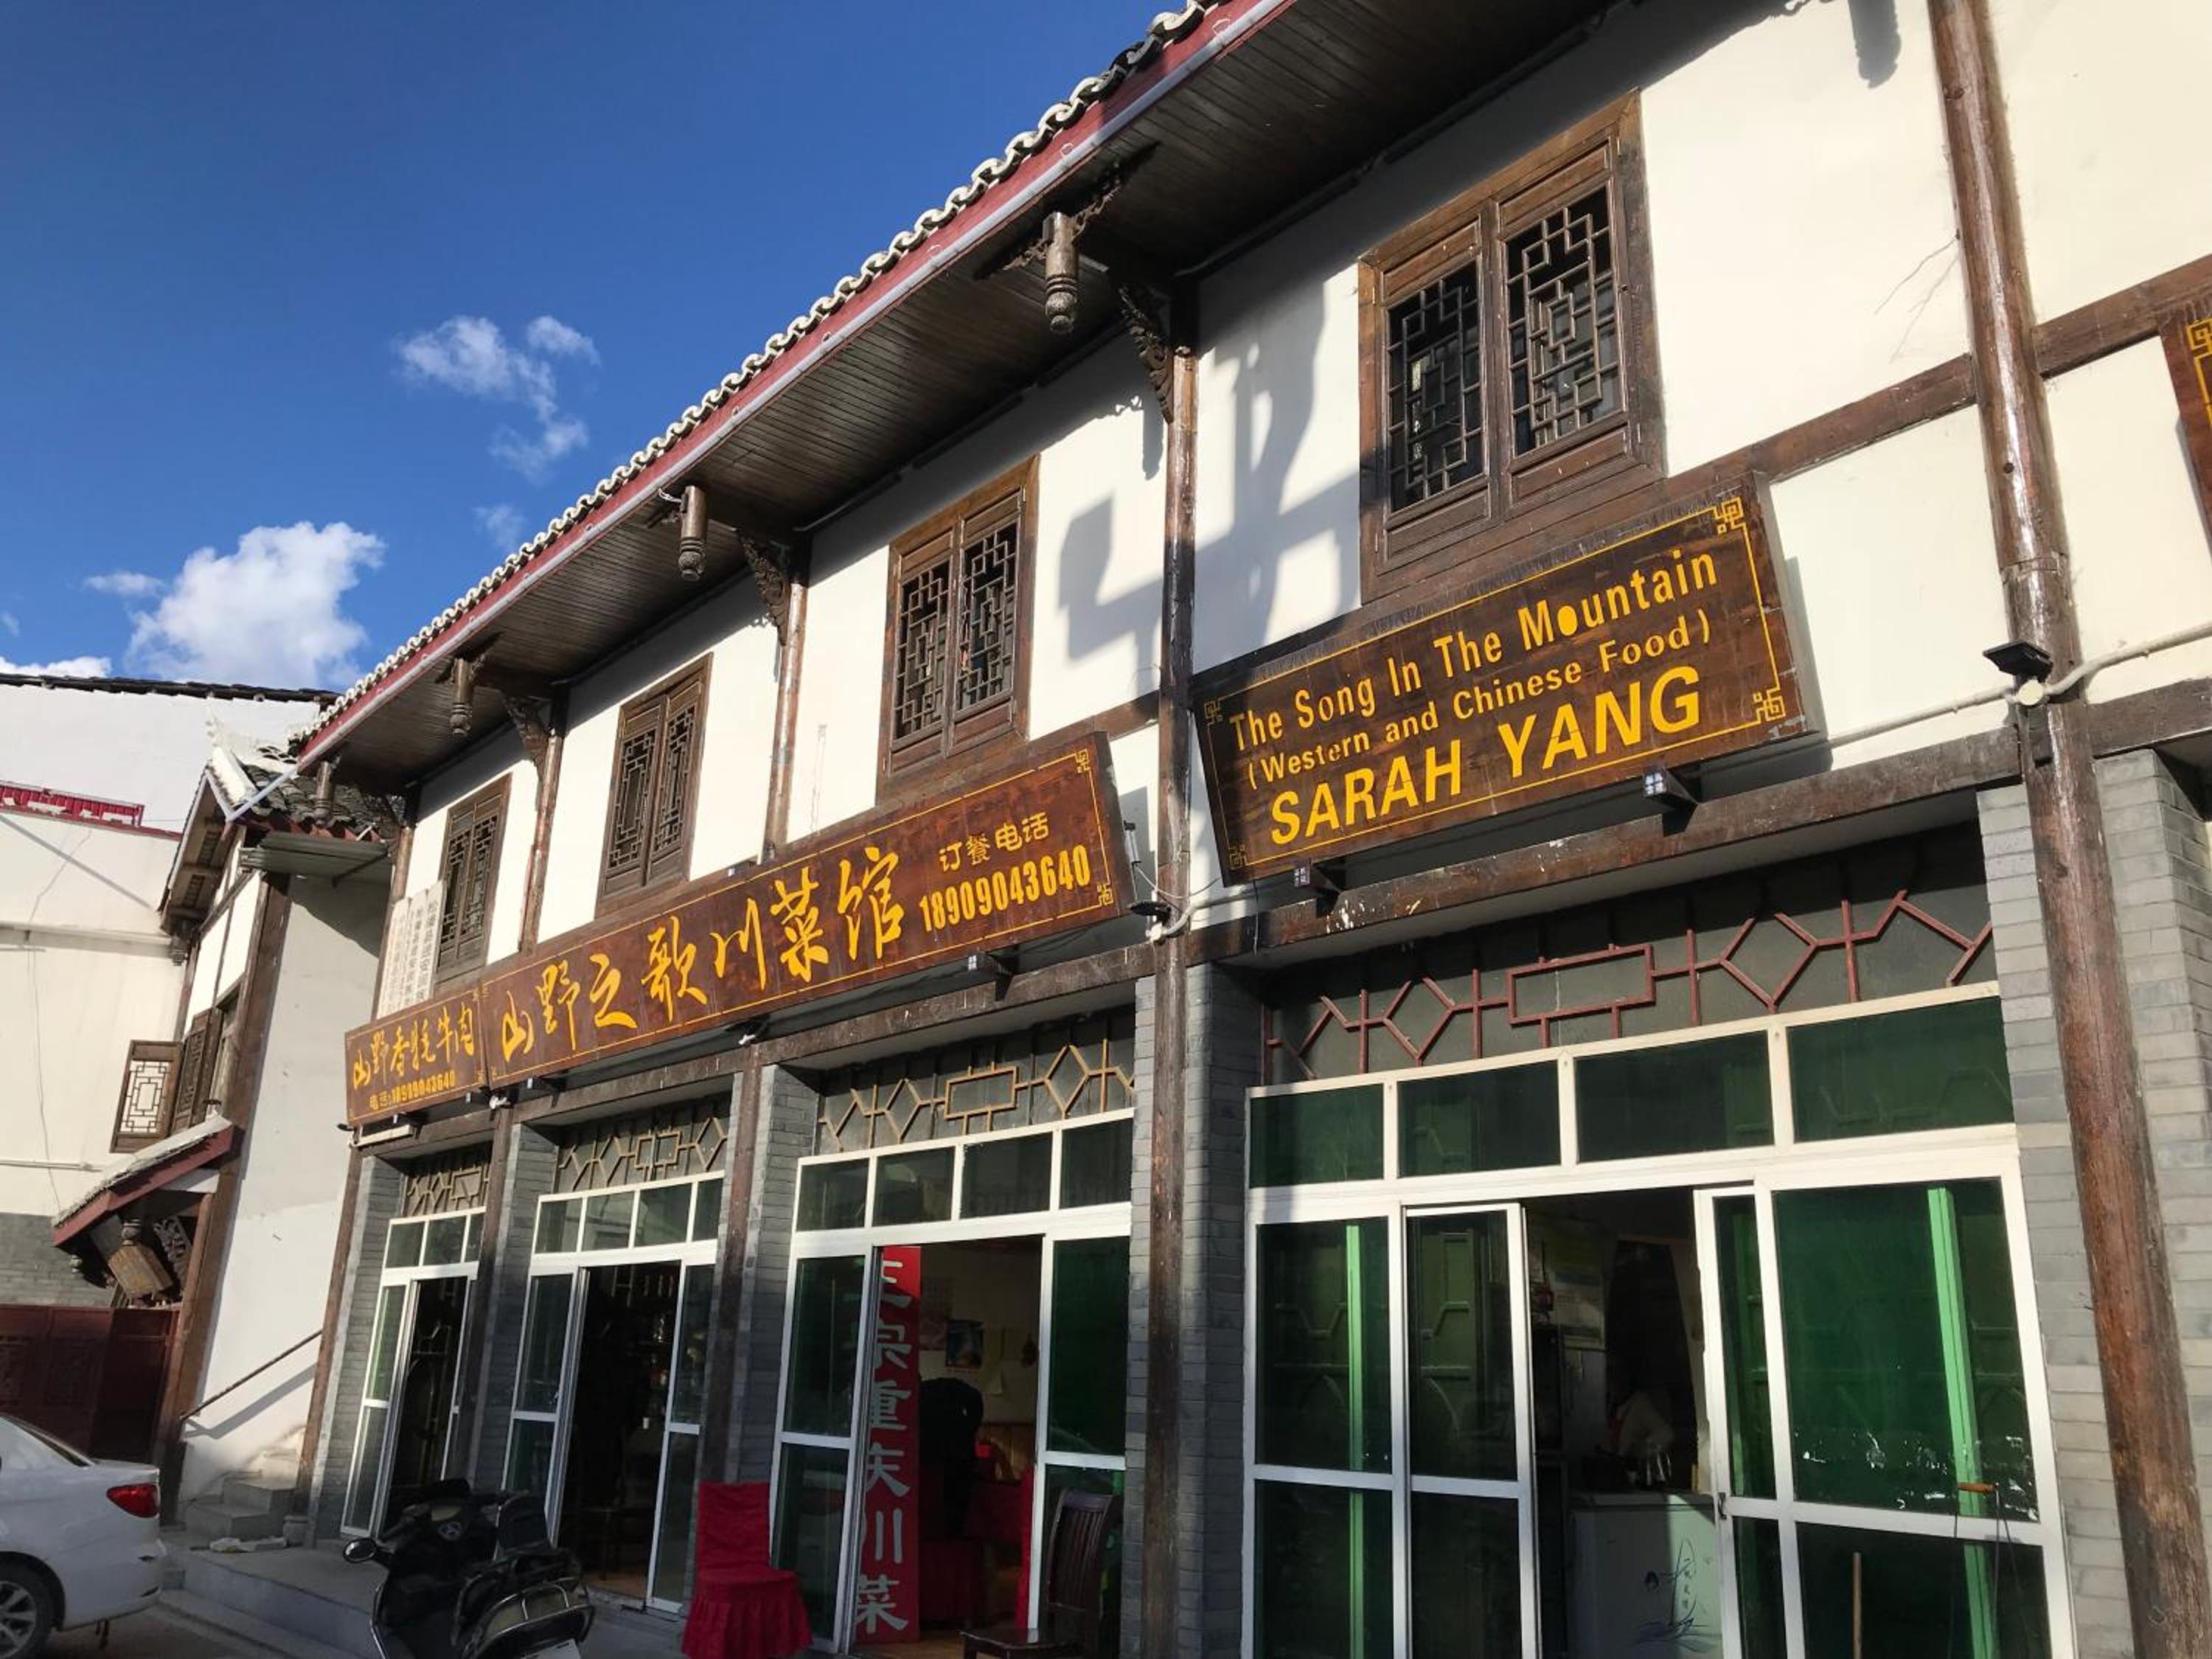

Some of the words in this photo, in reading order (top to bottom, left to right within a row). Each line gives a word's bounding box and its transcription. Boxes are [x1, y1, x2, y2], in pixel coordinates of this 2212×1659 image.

[1229, 709, 1284, 753] The
[1294, 678, 1377, 728] Song
[1387, 658, 1422, 696] In
[1433, 631, 1503, 678] The
[1517, 549, 1719, 650] Mountain
[1248, 731, 1371, 790] (Western
[1384, 702, 1439, 745] and
[1453, 660, 1583, 720] Chinese
[1599, 608, 1711, 674] Food)
[937, 811, 1050, 874] 订餐电话
[1270, 740, 1463, 846] SARAH
[1497, 664, 1701, 779] YANG
[501, 845, 906, 1063] 山野之歌川菜馆
[918, 843, 1092, 933] 18909043640
